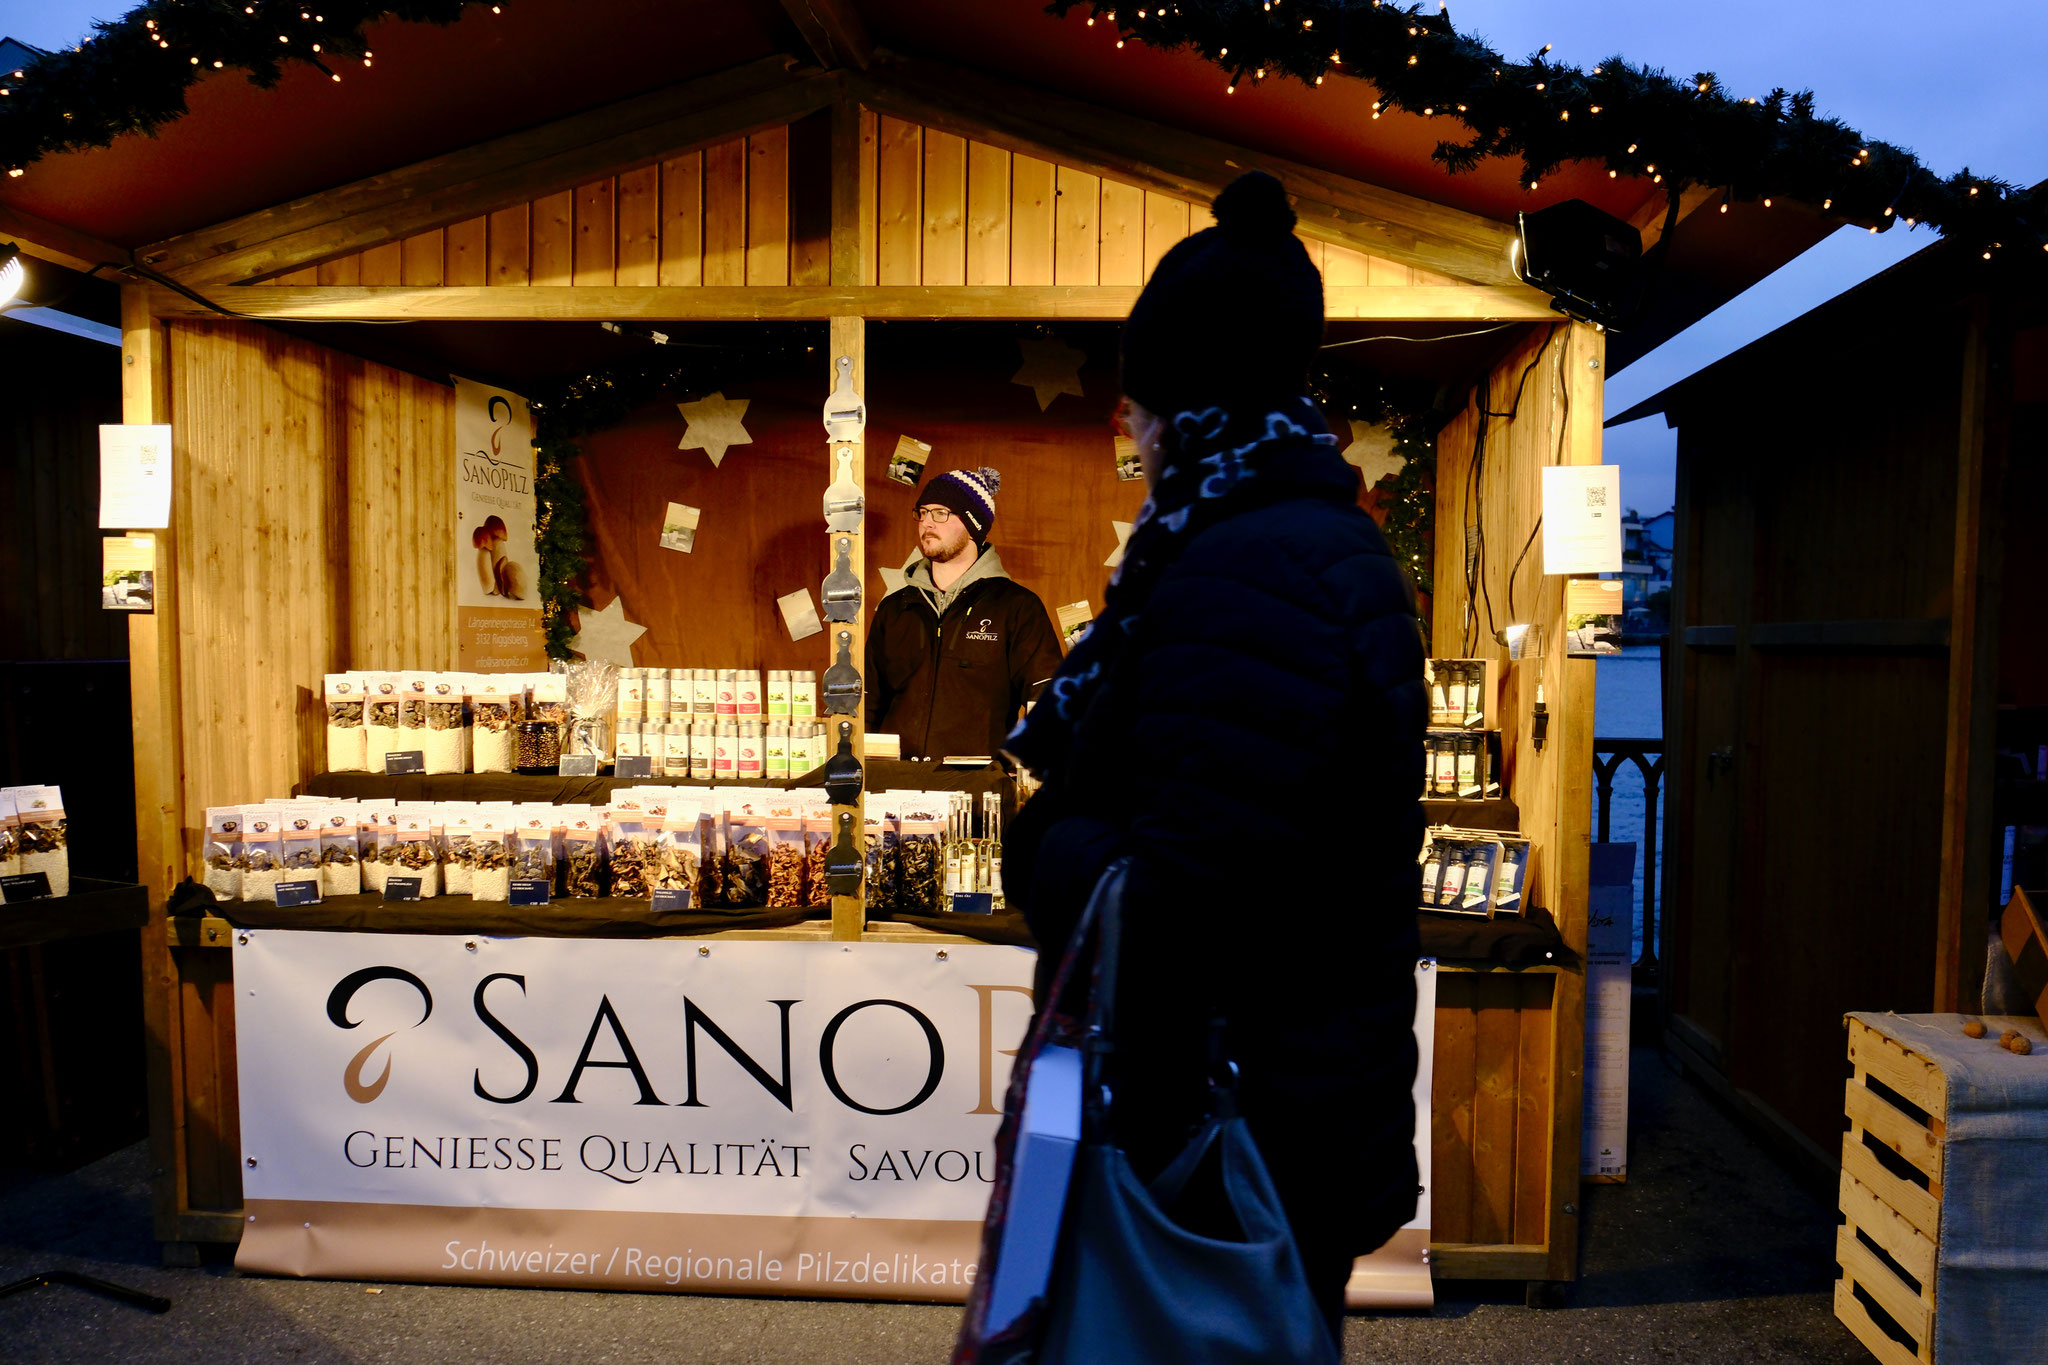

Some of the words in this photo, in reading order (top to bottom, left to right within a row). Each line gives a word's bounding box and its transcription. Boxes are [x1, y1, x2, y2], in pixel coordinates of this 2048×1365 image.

[463, 458, 529, 495] SANOPILZ
[965, 632, 998, 642] SANOPILZ
[344, 1130, 563, 1172] GENIESSE
[579, 1135, 810, 1184] QUALITÄT
[797, 1252, 978, 1286] Pilzdelikate
